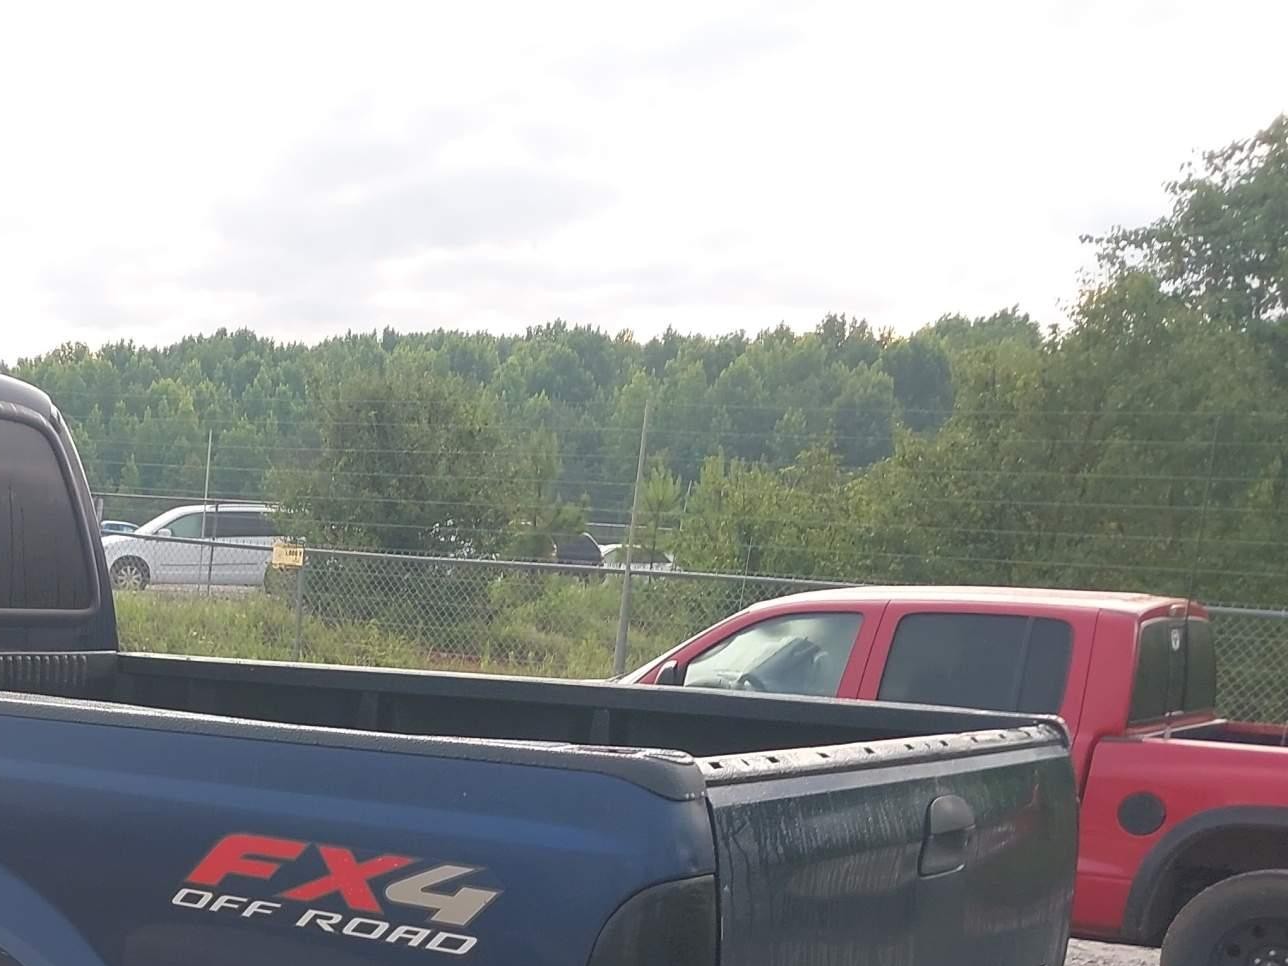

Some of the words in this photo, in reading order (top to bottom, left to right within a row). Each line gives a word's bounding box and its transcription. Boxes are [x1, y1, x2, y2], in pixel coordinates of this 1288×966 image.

[183, 833, 504, 926] FX4
[171, 888, 282, 918] OFF
[295, 909, 478, 955] ROAD
